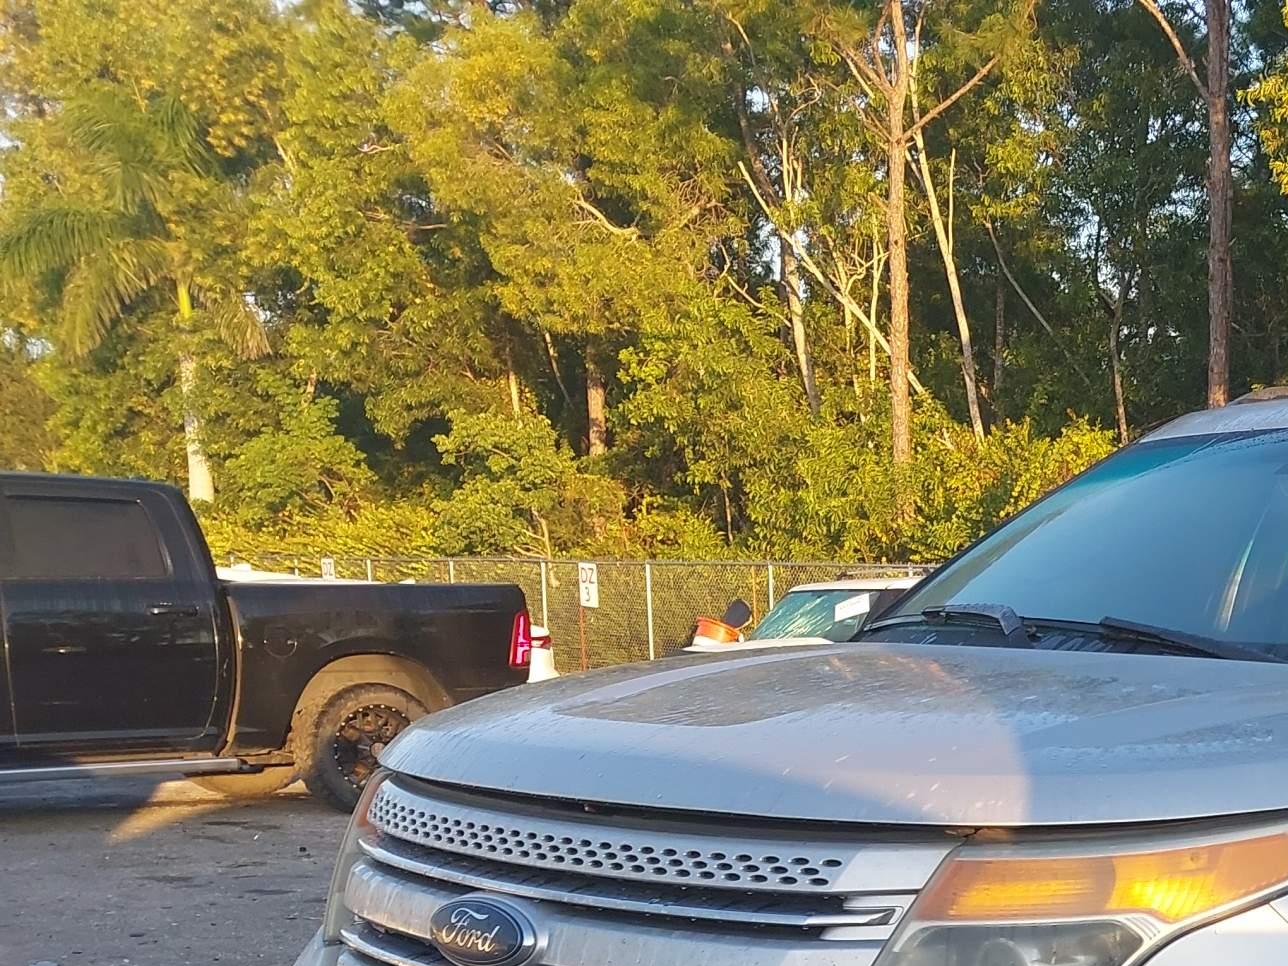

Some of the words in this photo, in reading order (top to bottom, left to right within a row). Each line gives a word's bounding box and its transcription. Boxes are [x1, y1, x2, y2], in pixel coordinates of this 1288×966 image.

[580, 567, 596, 584] DZ
[584, 586, 591, 602] 3
[442, 907, 500, 952] Ford
